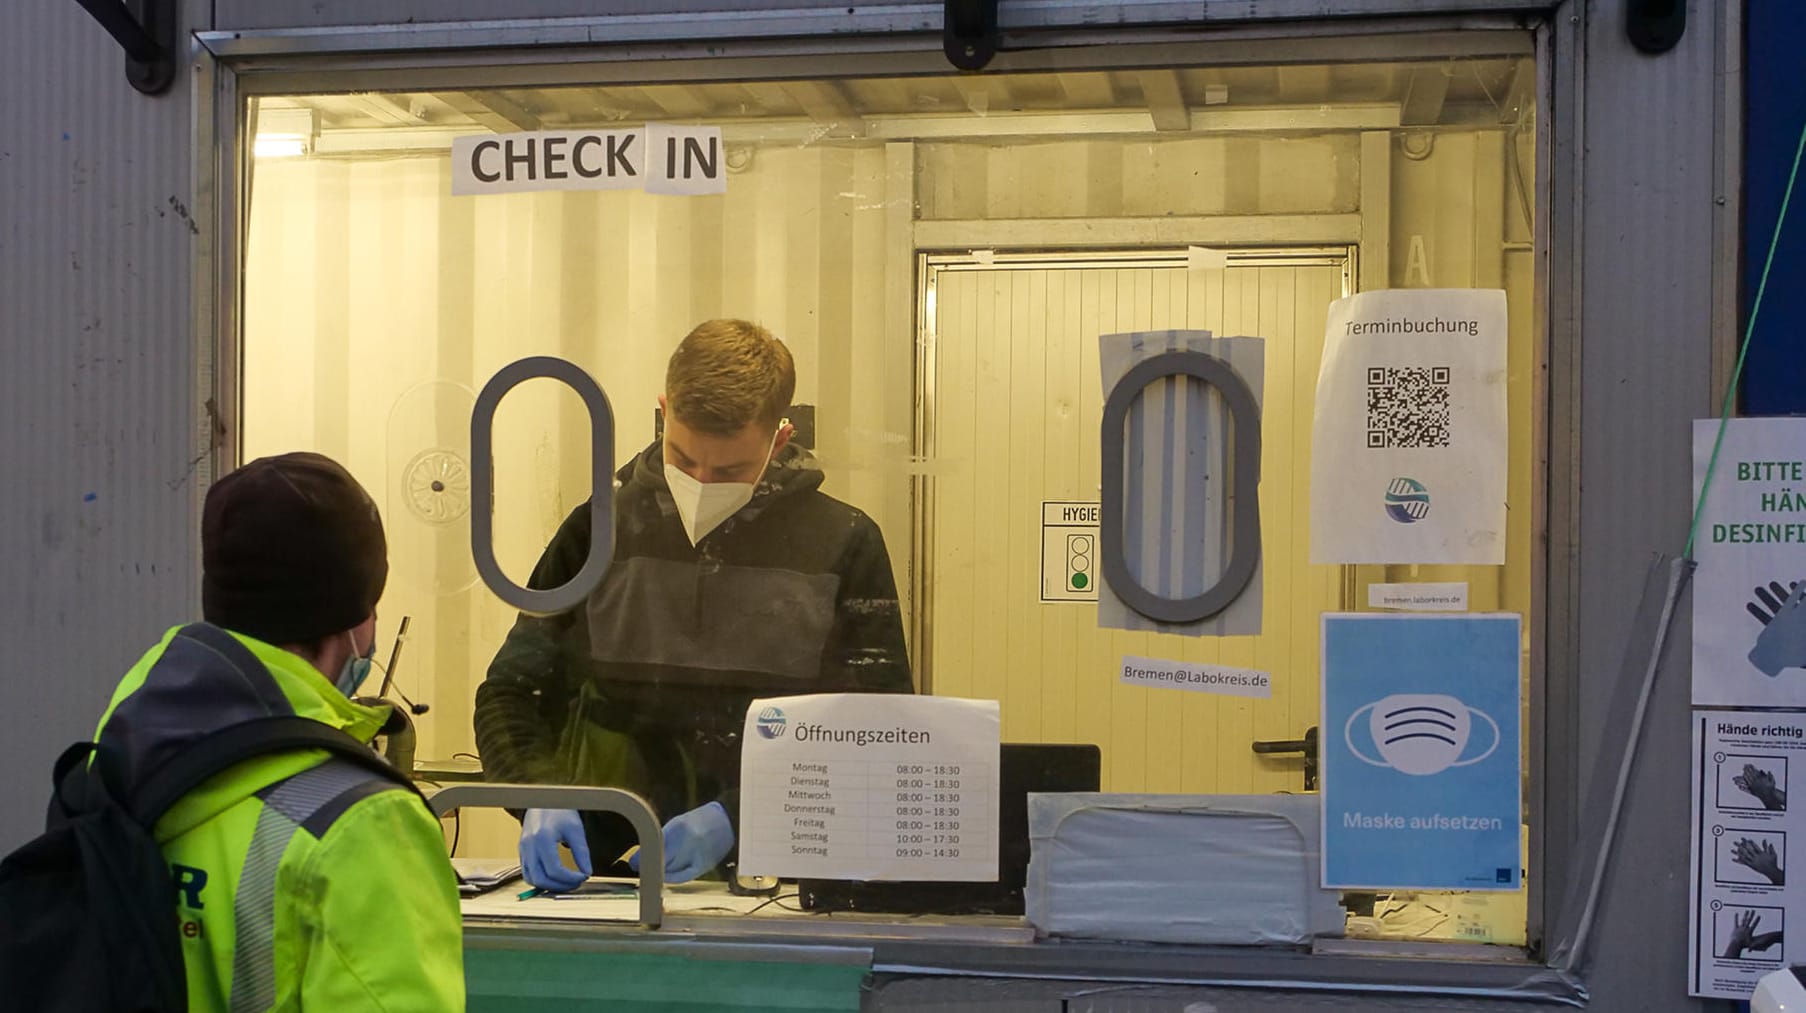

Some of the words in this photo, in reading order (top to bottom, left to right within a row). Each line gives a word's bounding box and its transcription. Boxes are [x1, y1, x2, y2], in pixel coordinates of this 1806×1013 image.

[470, 133, 637, 182] CHECK
[666, 136, 718, 179] IN
[1345, 317, 1479, 337] Terminbuchung
[1737, 462, 1802, 481] BITTE
[1063, 507, 1101, 521] HYGIE
[1124, 665, 1268, 688] Bremen@Labokreis.de
[795, 723, 930, 745] Öffnungszeiten
[1717, 723, 1758, 735] Hände
[1761, 725, 1804, 739] richtig
[793, 763, 827, 774] Montag
[897, 766, 923, 774] 08:00
[934, 766, 959, 774] 18:30
[791, 777, 829, 787] Dienstag
[897, 780, 923, 788] 08:00
[934, 780, 959, 788] 18:30
[788, 791, 831, 800] Mittwoch
[897, 794, 923, 802] 08:00
[934, 794, 959, 802] 18:30
[784, 805, 835, 815] Donnerstag
[897, 807, 923, 816] 08:00
[934, 807, 959, 816] 18:30
[794, 818, 824, 829] Freitag
[897, 821, 923, 830] 08:00
[934, 821, 959, 830] 18:30
[1343, 812, 1405, 830] Maske
[1411, 813, 1502, 830] aufsetzen
[791, 832, 828, 843] Samstag
[897, 835, 923, 844] 10:00
[934, 835, 959, 844] 17:30
[791, 846, 827, 856] Sonntag
[897, 849, 923, 857] 09:00
[934, 849, 959, 857] 14:30
